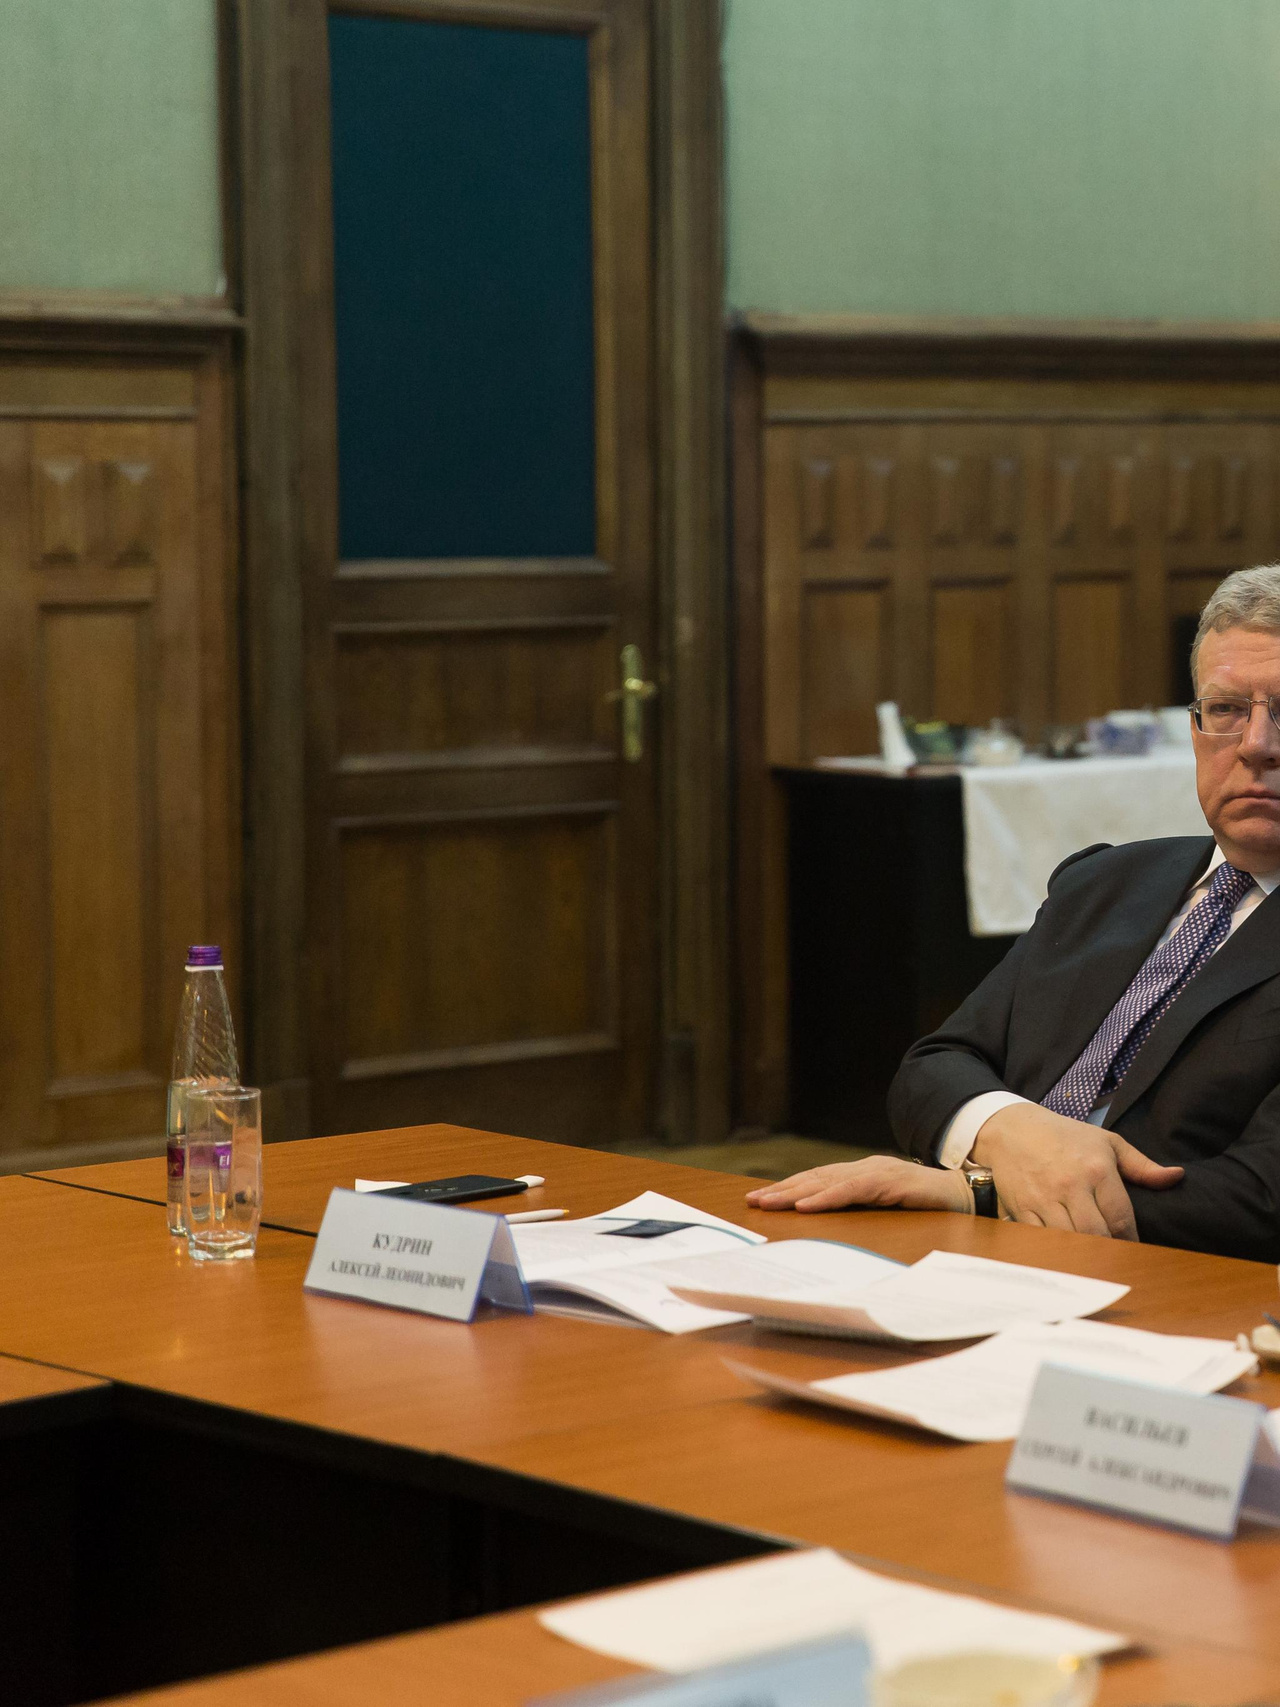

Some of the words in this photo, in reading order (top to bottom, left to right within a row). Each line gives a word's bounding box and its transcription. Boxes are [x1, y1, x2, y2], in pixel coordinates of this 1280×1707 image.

[372, 1232, 433, 1255] КУДРИН
[328, 1260, 381, 1278] АЛЕКСЕЙ
[381, 1266, 465, 1291] ЛЕОНИДОВИЧ
